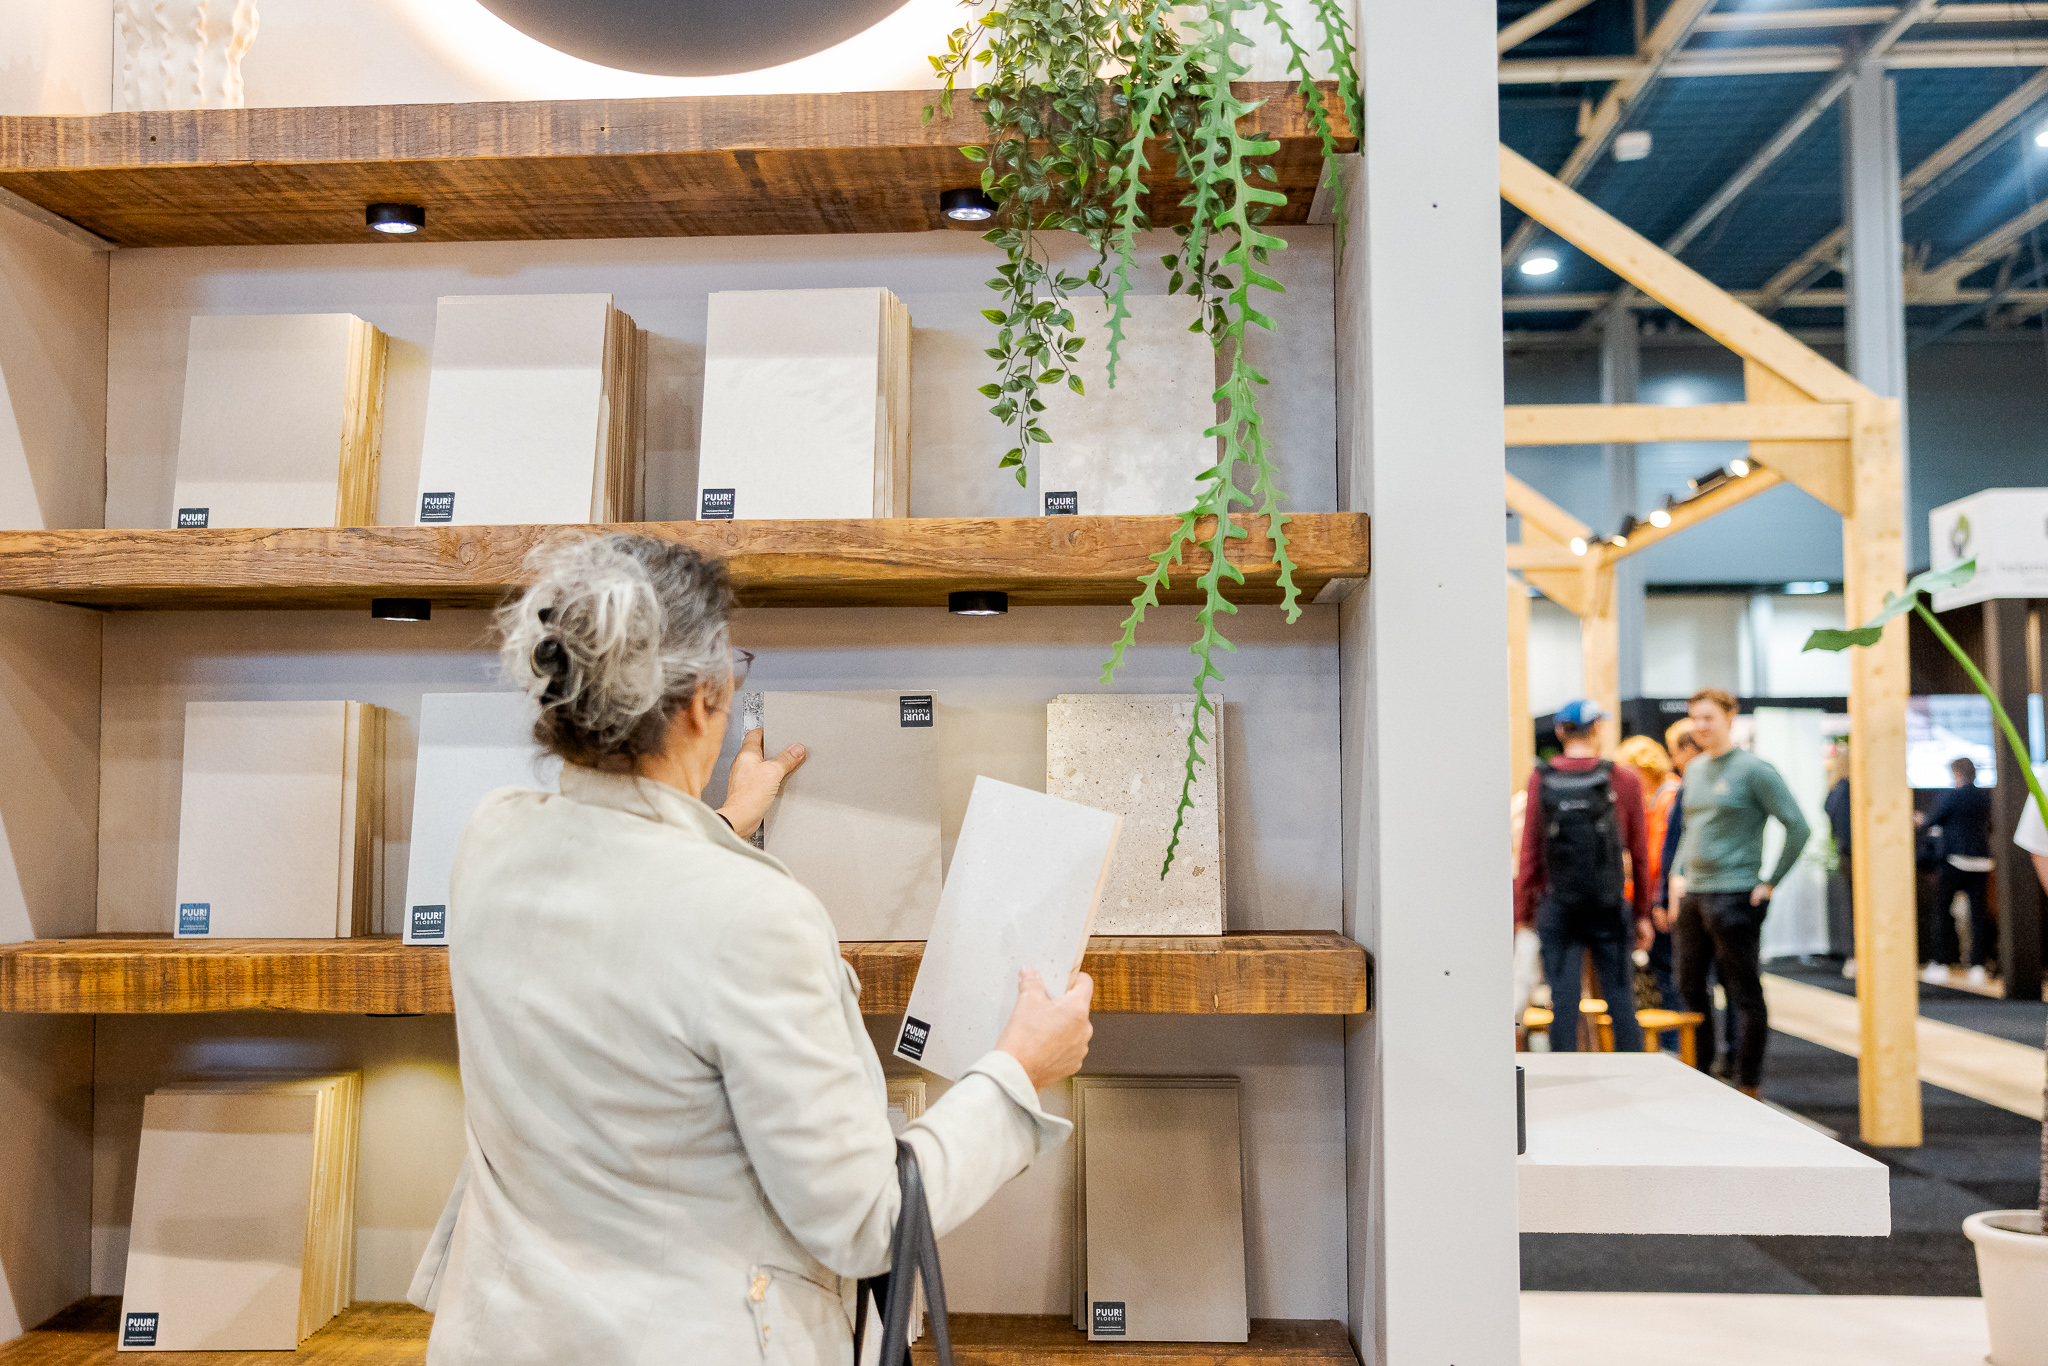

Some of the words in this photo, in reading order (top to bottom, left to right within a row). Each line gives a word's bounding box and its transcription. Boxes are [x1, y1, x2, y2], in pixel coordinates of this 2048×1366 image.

[424, 497, 451, 505] PUUR!
[704, 493, 732, 501] PUUR!
[1047, 497, 1075, 505] PUUR!
[180, 513, 206, 521] PUUR!
[903, 713, 930, 721] PUUR!
[182, 908, 207, 917] PUUR!
[414, 911, 442, 920] PUUR!
[905, 1023, 927, 1040] PUUR!
[1095, 1308, 1122, 1317] PUUR!
[128, 1318, 156, 1327] PUUR!
